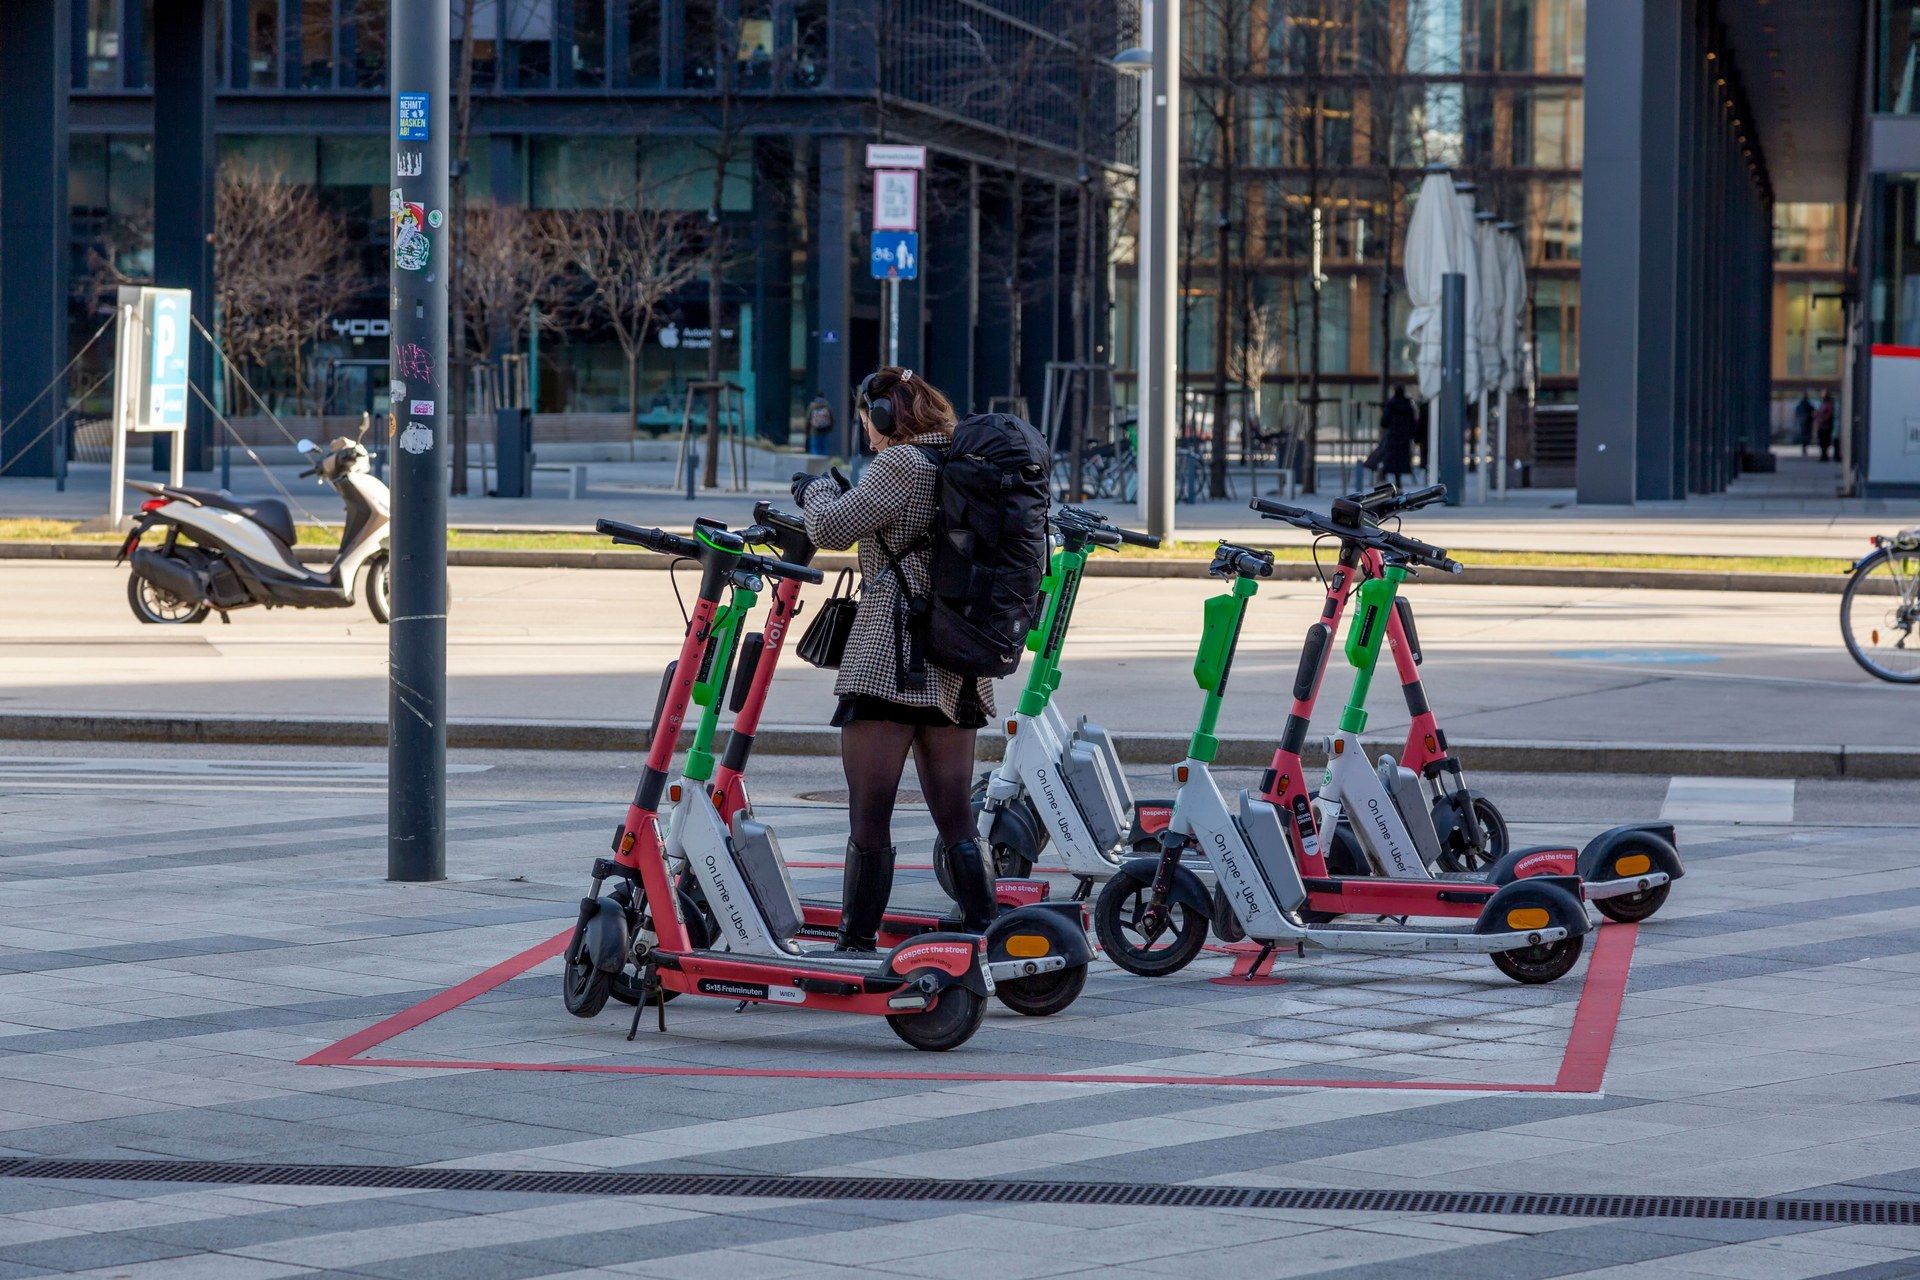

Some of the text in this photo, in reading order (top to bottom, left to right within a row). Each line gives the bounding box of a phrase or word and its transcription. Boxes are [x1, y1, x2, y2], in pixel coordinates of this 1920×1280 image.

[400, 100, 422, 109] NEHMT
[400, 110, 410, 118] DIE
[400, 119, 426, 128] MASKEN
[156, 314, 176, 379] P
[1037, 769, 1047, 785] On
[1043, 784, 1058, 809] Lime
[1058, 817, 1073, 842] Uber
[1368, 799, 1379, 815] On
[1375, 814, 1391, 840] Lime
[1391, 847, 1406, 872] Uber
[1519, 855, 1545, 870] Respect
[1215, 834, 1226, 851] On
[1222, 851, 1240, 878] Lime
[1242, 886, 1260, 914] Uber
[1018, 885, 1039, 893] street
[705, 855, 716, 874] On
[712, 873, 730, 902] Lime
[731, 911, 749, 940] Uber
[801, 927, 839, 937] Freiminuten
[897, 946, 968, 963] Respect the street
[722, 985, 763, 996] Freiminuten
[780, 990, 796, 998] WIEN
